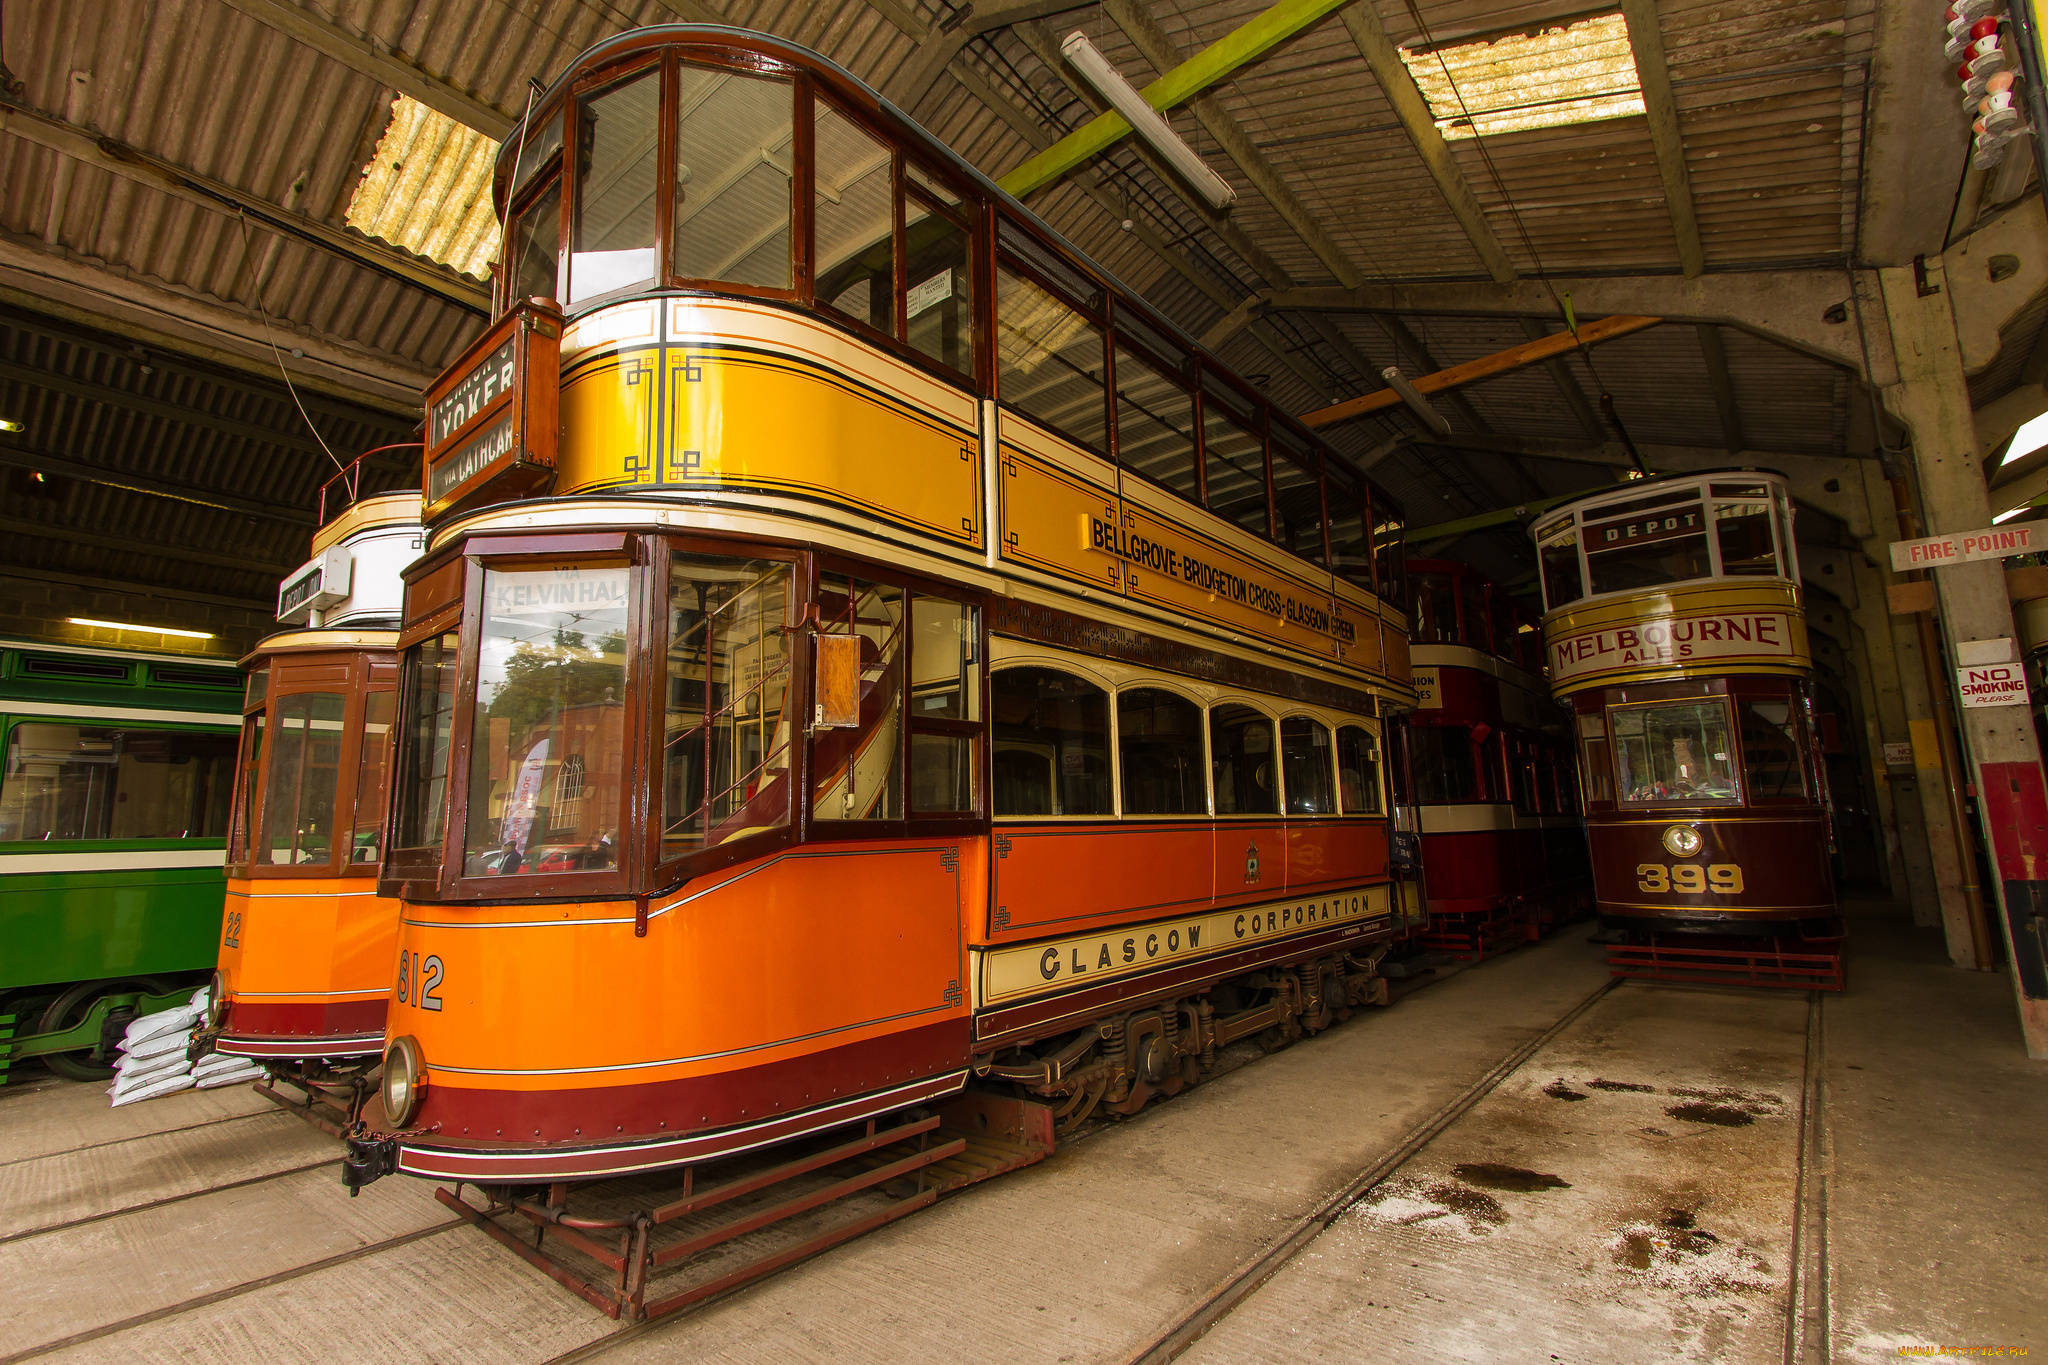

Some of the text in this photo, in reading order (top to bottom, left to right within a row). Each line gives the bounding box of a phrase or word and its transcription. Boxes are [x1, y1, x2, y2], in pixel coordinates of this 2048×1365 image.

[444, 468, 457, 486] VIA
[1606, 513, 1697, 542] DEPOT
[1910, 529, 2030, 562] FIRE POINT
[554, 565, 581, 580] VIA
[496, 582, 576, 607] KELVIN
[1330, 615, 1355, 642] GREEN
[1556, 617, 1780, 670] MELBOURNE
[1623, 643, 1693, 664] ALES
[753, 653, 782, 664] PAENGERS
[1961, 680, 2025, 696] SMOKING
[1968, 668, 2011, 683] NO
[1975, 694, 2015, 704] PLEASE
[1636, 863, 1745, 894] 399
[224, 911, 242, 949] 22
[1039, 894, 1370, 981] GLASGOW CORPORATION
[397, 949, 444, 1012] 812
